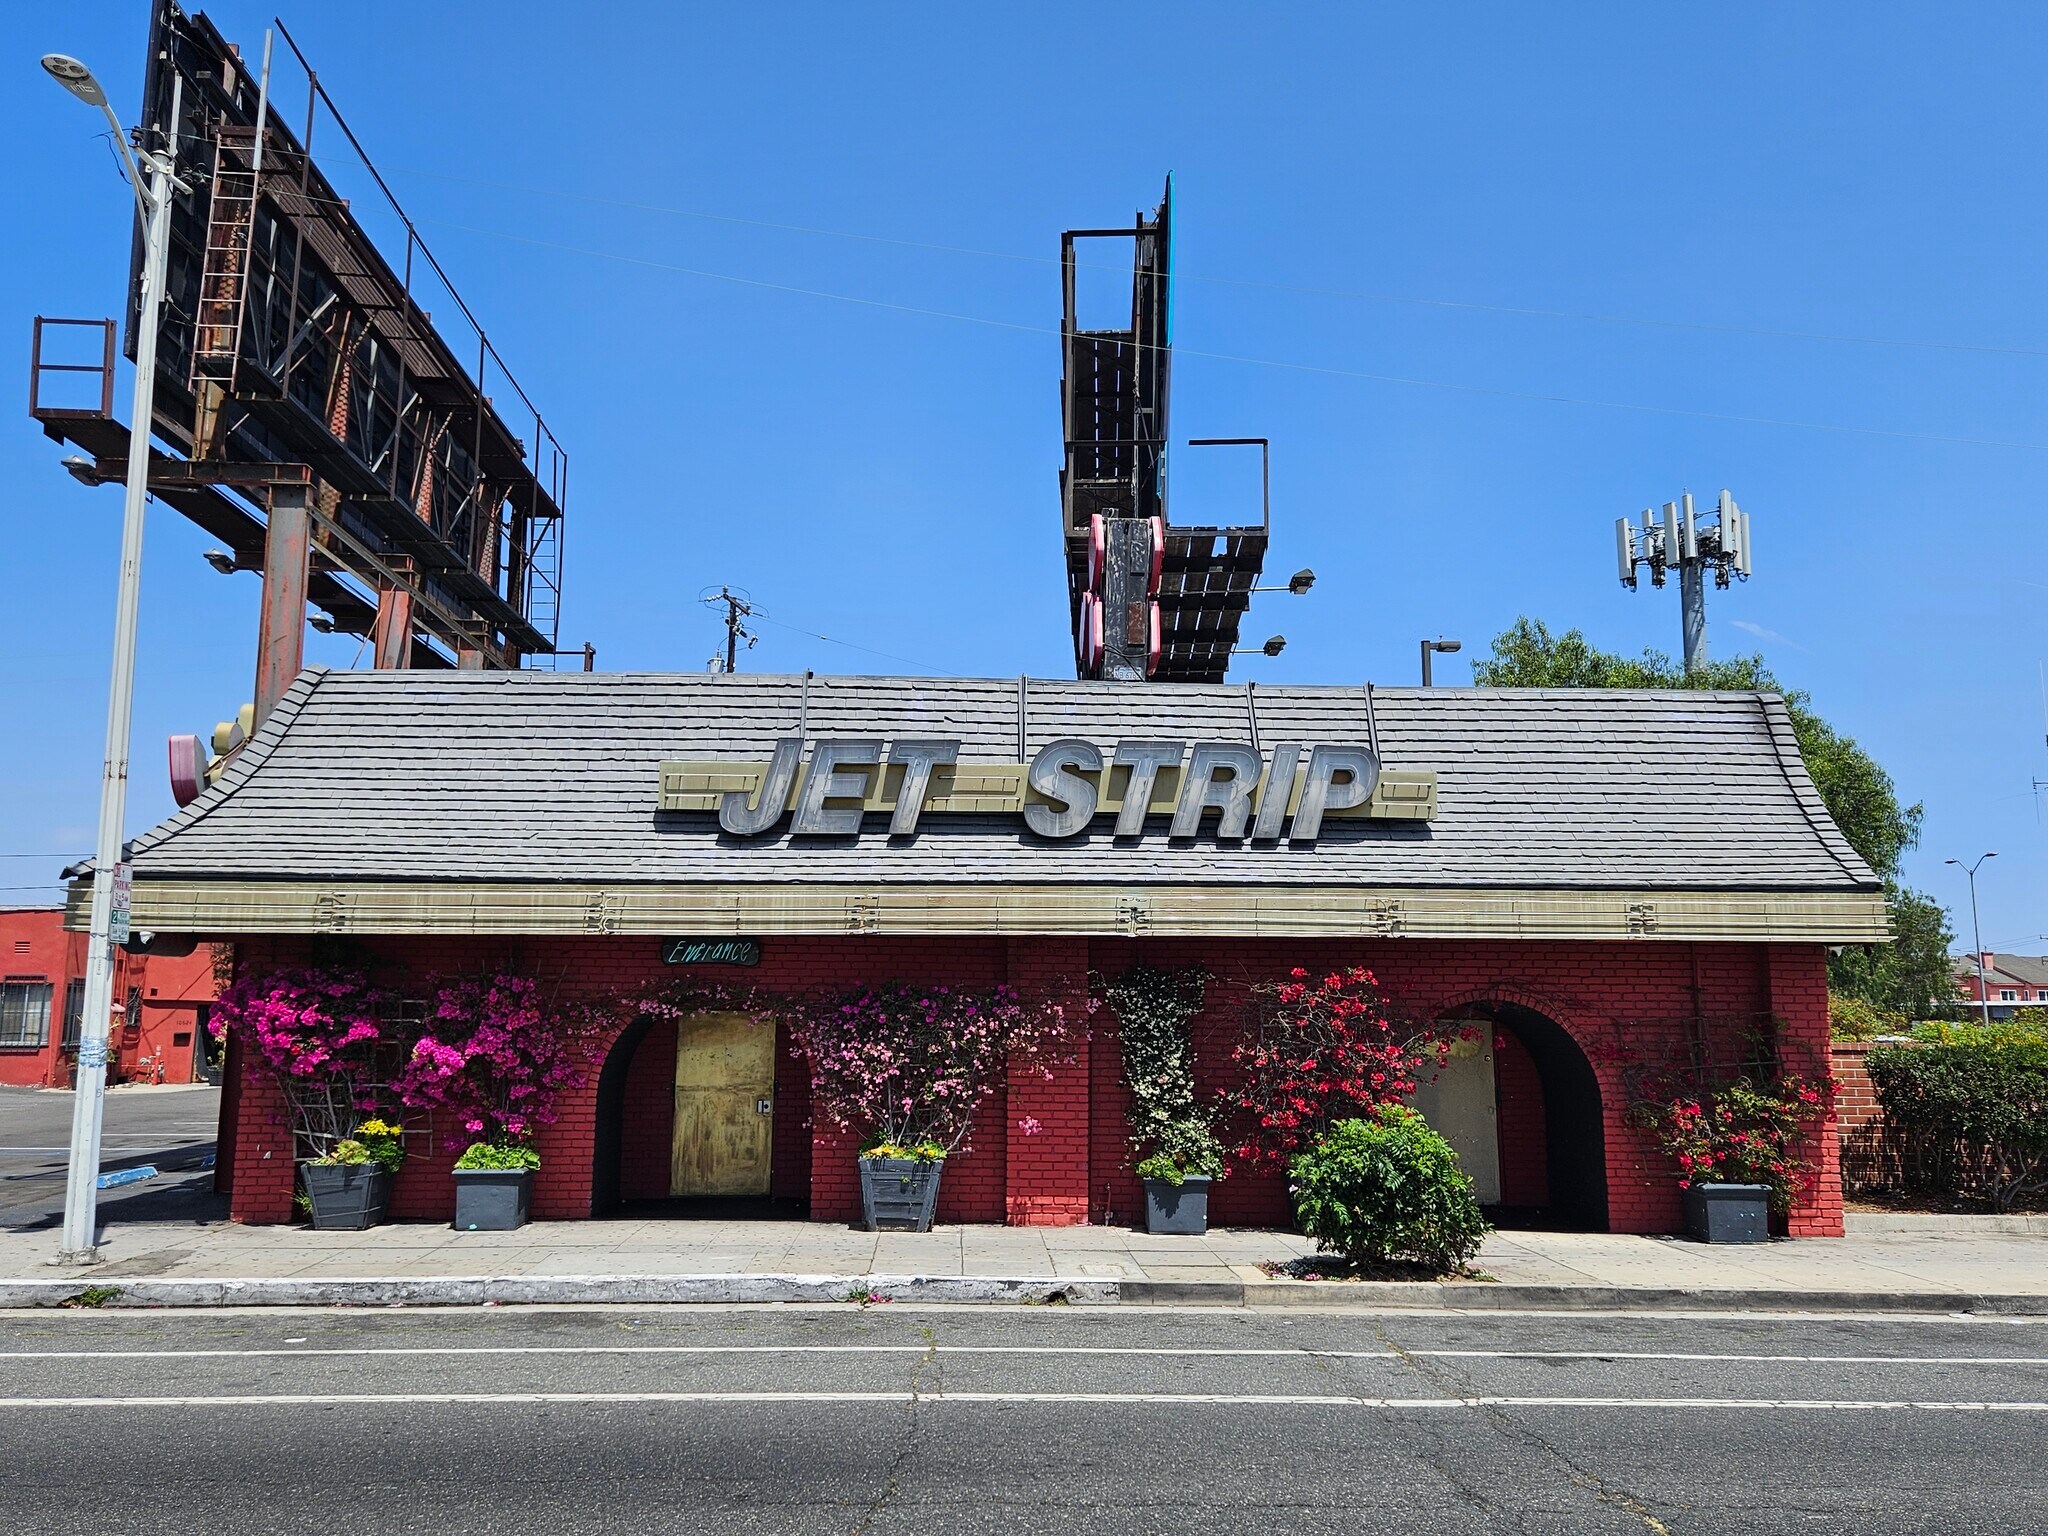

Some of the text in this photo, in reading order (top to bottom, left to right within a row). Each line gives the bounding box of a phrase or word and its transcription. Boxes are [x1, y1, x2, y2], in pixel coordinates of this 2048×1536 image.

[719, 738, 1381, 840] JET STRIP
[112, 911, 118, 923] 2
